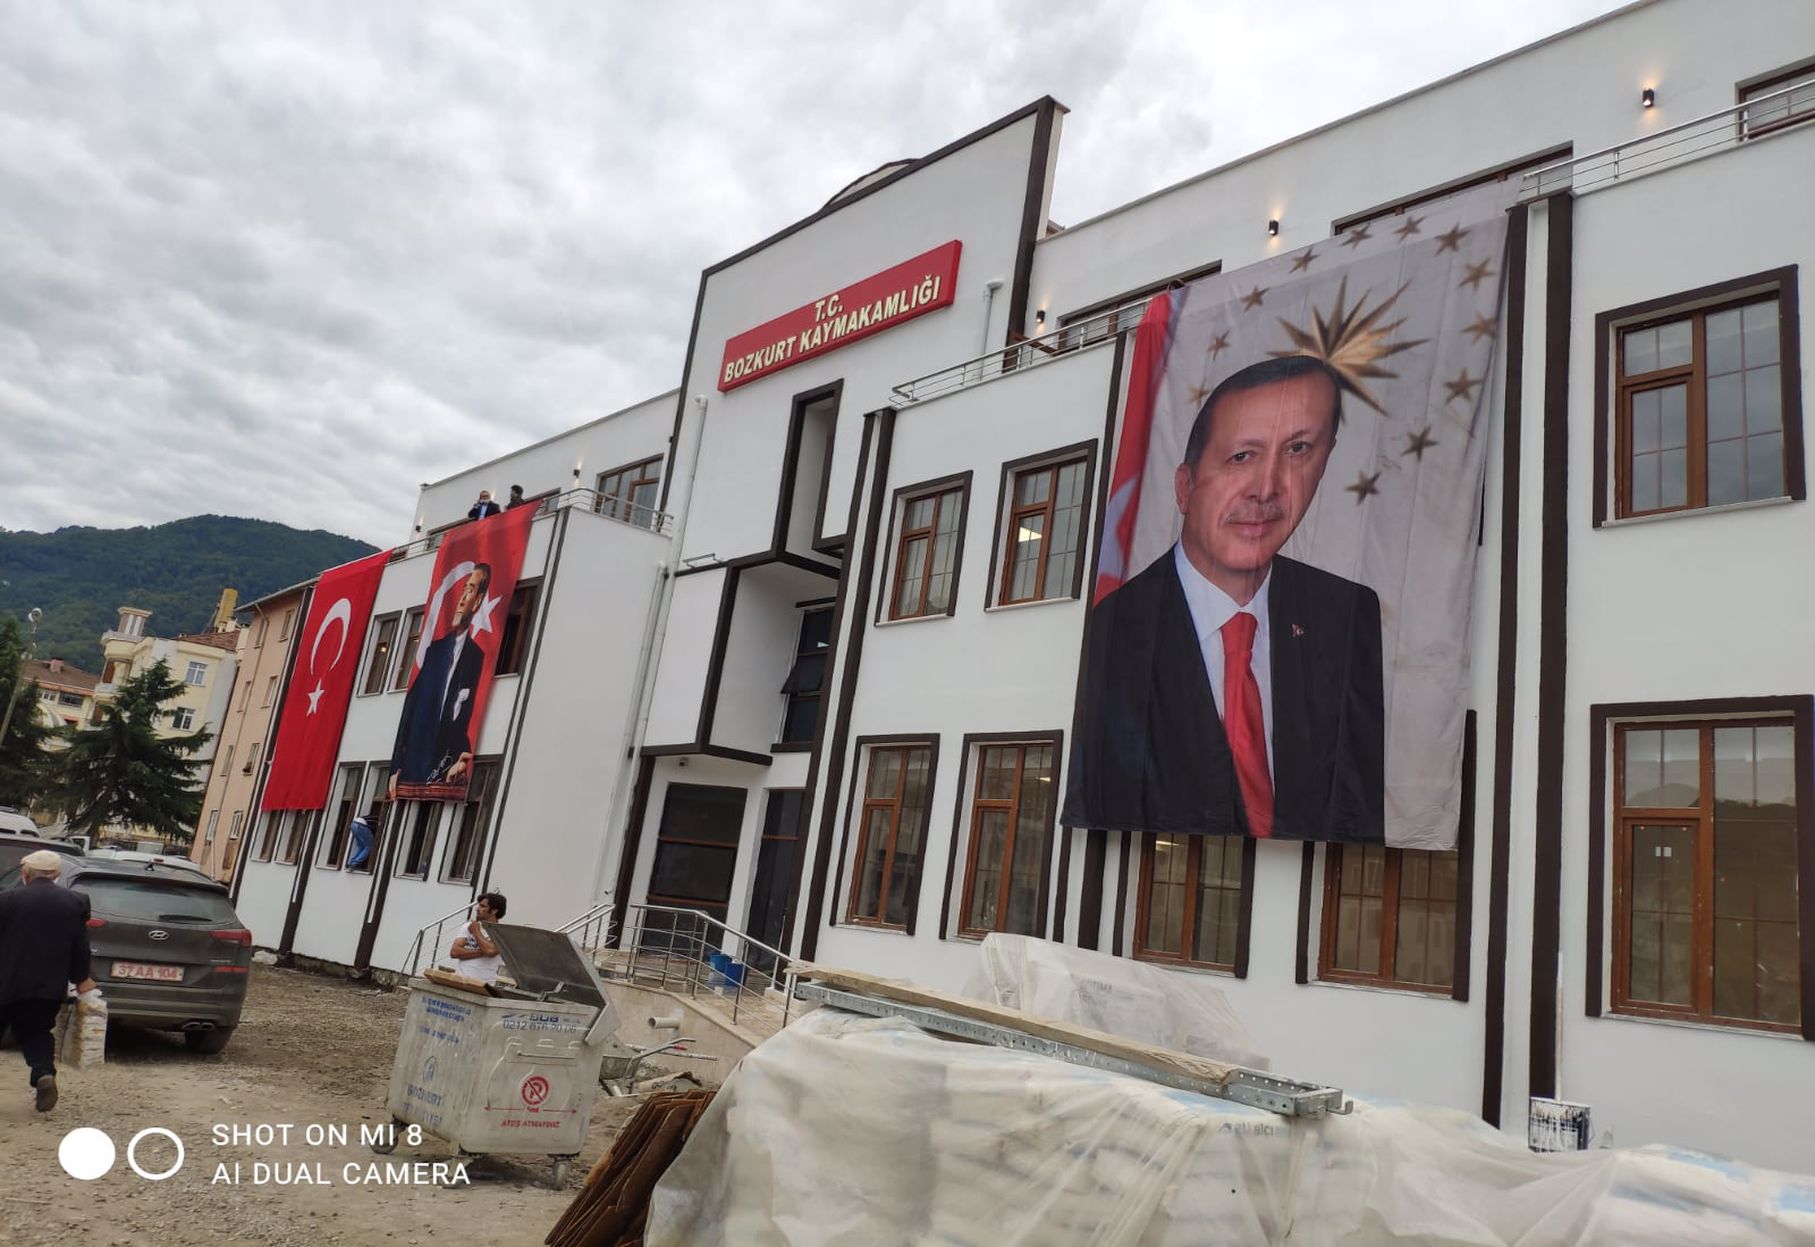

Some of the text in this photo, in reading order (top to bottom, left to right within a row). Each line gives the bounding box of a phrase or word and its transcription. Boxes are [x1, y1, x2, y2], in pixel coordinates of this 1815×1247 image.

[815, 294, 843, 322] T.C.
[724, 275, 940, 383] BOZKURT KAYMAKAMLIĞI
[119, 965, 177, 979] 37 AA 104
[502, 1019, 527, 1031] 0212
